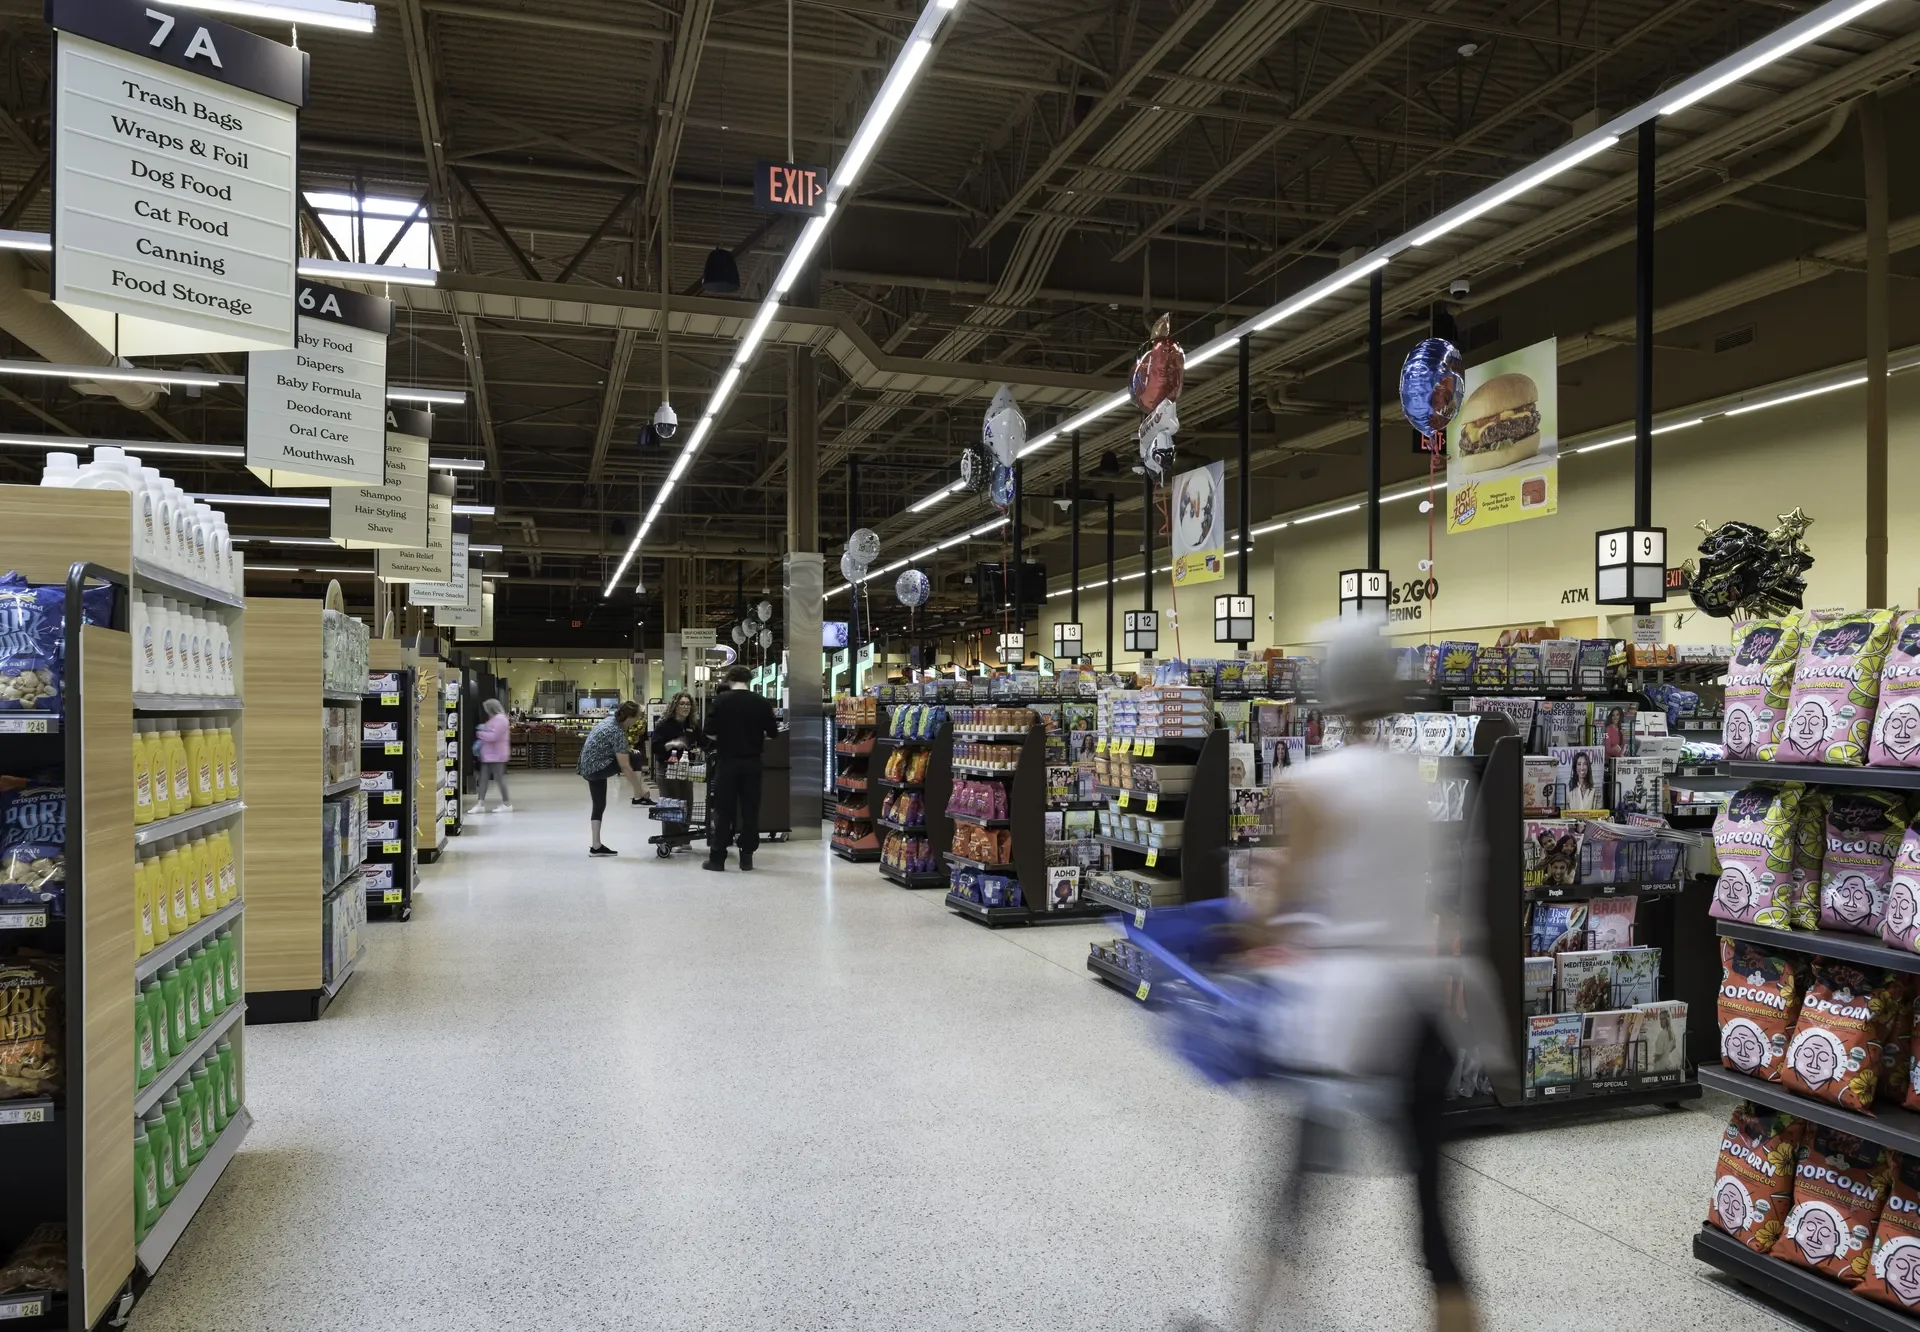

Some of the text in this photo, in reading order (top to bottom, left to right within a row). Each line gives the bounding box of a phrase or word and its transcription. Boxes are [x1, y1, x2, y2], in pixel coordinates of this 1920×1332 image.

[122, 80, 243, 132] Trash Bags
[111, 115, 249, 170] Wraps & Foil
[130, 159, 232, 202] Dog Food
[770, 166, 816, 206] EXIT
[134, 200, 229, 238] Cat Food
[136, 238, 226, 276] Canning
[111, 269, 253, 316] Food Storage
[298, 333, 353, 353] aby Food
[296, 355, 345, 375] Diapers
[276, 374, 362, 400] Baby Formula
[286, 400, 353, 421] Deodorant
[386, 410, 398, 428] A
[289, 423, 349, 443] Oral Care
[282, 446, 355, 466] Mouthwash
[385, 477, 402, 487] oap
[360, 489, 402, 502] Shampoo
[1455, 488, 1471, 505] HOT
[354, 504, 407, 520] Hair Styling
[1454, 496, 1477, 520] ZONE
[367, 523, 394, 534] Shave
[1610, 539, 1617, 557] 9
[1644, 537, 1652, 555] 9
[416, 552, 434, 560] Relief
[391, 563, 420, 572] Sanitary
[1369, 577, 1380, 591] 10
[1666, 569, 1683, 587] EXIT
[1402, 578, 1439, 603] 2GO
[1561, 588, 1589, 604] ATM
[20, 601, 44, 611] fried
[1237, 601, 1246, 612] 11
[1389, 605, 1422, 622] ERING
[1142, 616, 1151, 627] 12
[1011, 636, 1018, 644] 14
[1068, 627, 1076, 636] 13
[859, 650, 868, 658] 15
[1445, 642, 1477, 651] Prevention
[834, 655, 843, 663] 16
[1547, 660, 1572, 668] SEARCH
[1795, 664, 1863, 684] POPCORN
[1617, 766, 1660, 775] PRO FOOTBALL
[12, 796, 38, 804] crispy
[1714, 831, 1776, 850] POPCORN
[1826, 838, 1898, 857] PCORN
[1550, 908, 1568, 917] Tast
[1593, 901, 1632, 915] BRAIN
[1564, 960, 1611, 969] MEDITERRANEAN
[20, 978, 44, 986] fried
[1718, 1001, 1788, 1019] ATERMELON HIBISCUS
[1803, 995, 1875, 1021] OPCORN
[0, 1010, 47, 1040] NDS
[1533, 1019, 1556, 1028] Highlights
[1800, 1010, 1835, 1026] ERMELON
[1532, 1027, 1579, 1037] Hidden Pictures
[1604, 1080, 1628, 1088] SPECIALS
[1796, 1164, 1878, 1202] POPCORN
[1795, 1181, 1836, 1198] ATERMELON
[1837, 1193, 1877, 1212] HIBISCUS
